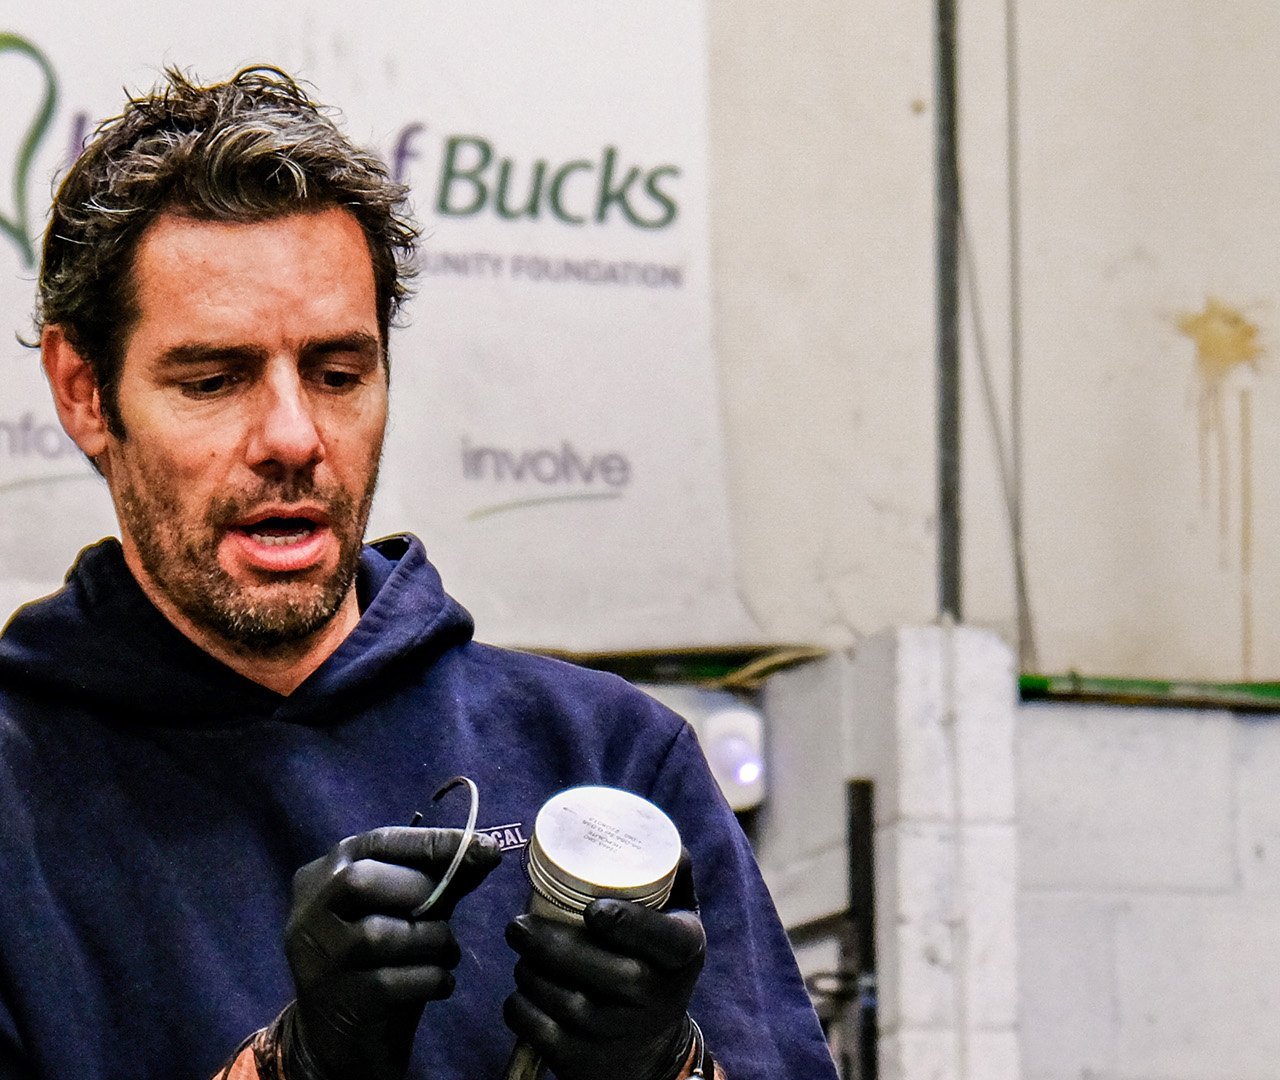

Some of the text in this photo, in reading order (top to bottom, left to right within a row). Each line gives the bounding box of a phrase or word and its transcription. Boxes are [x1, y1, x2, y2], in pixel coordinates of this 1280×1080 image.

[392, 122, 682, 231] f Bucks
[420, 252, 683, 288] UNITY FOUNDATION
[459, 433, 631, 487] involve
[490, 827, 528, 848] CAL
